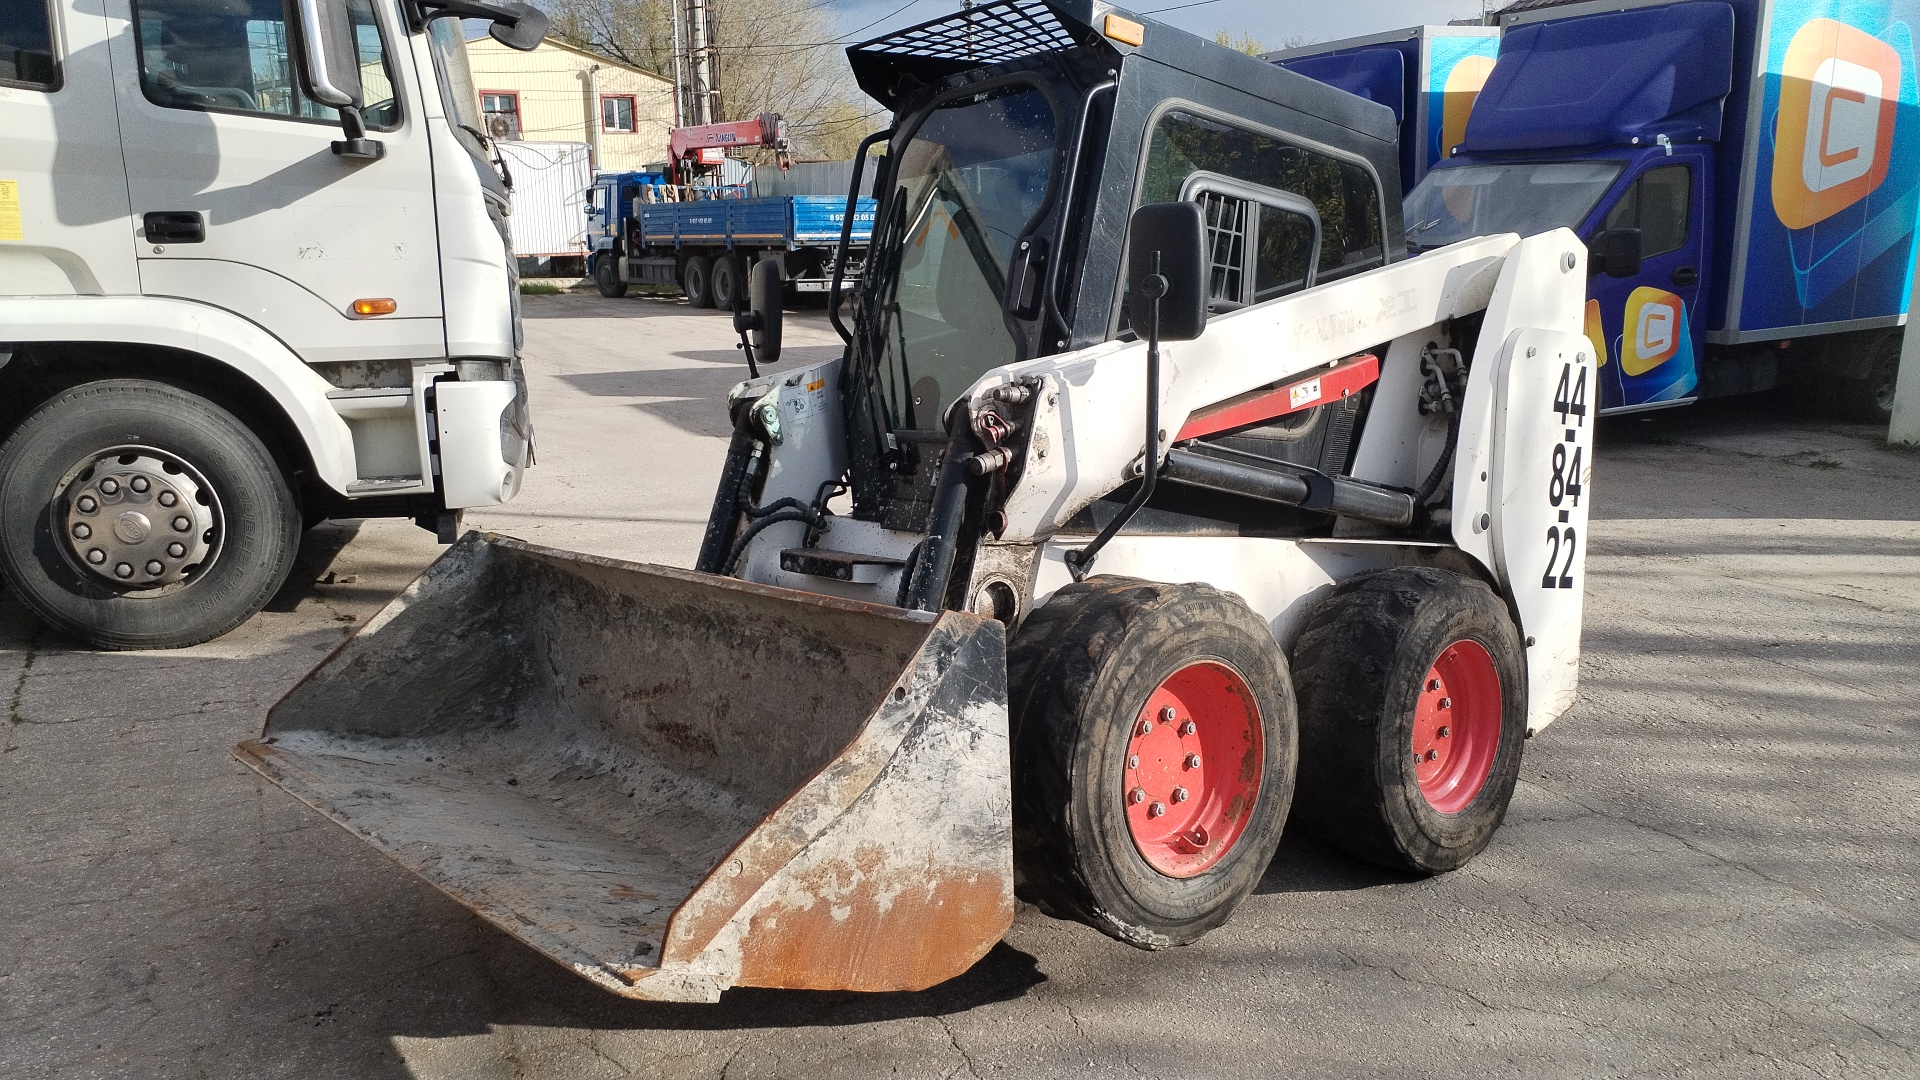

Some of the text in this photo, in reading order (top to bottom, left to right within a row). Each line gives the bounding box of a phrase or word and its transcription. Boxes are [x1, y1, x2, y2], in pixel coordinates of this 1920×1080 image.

[1553, 362, 1587, 426] 44
[1548, 445, 1583, 509] 84
[1541, 525, 1577, 590] 22
